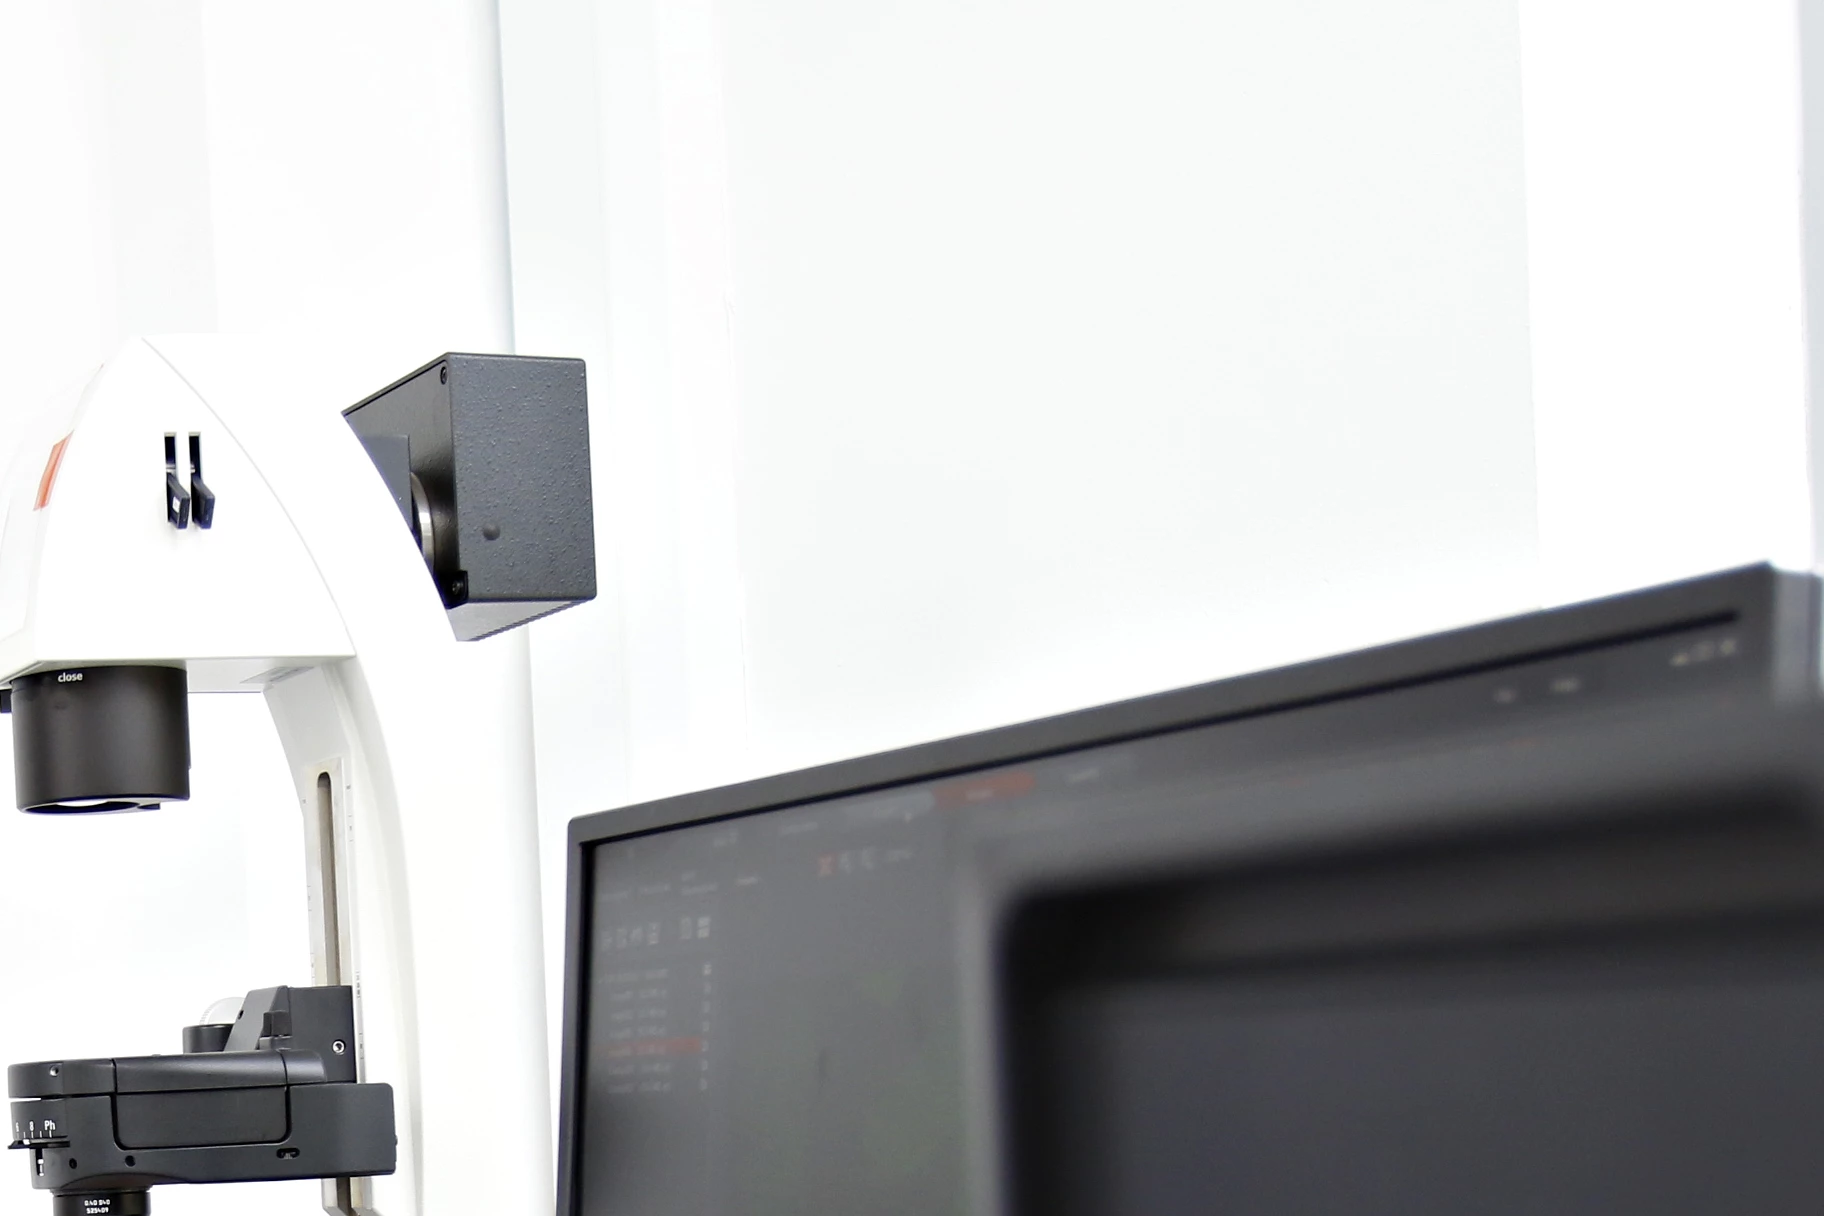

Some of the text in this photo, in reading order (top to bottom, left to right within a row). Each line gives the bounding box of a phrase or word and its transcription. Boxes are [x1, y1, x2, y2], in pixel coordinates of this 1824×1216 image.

[58, 672, 83, 682] close
[29, 1121, 34, 1131] 8
[44, 1120, 56, 1130] Ph
